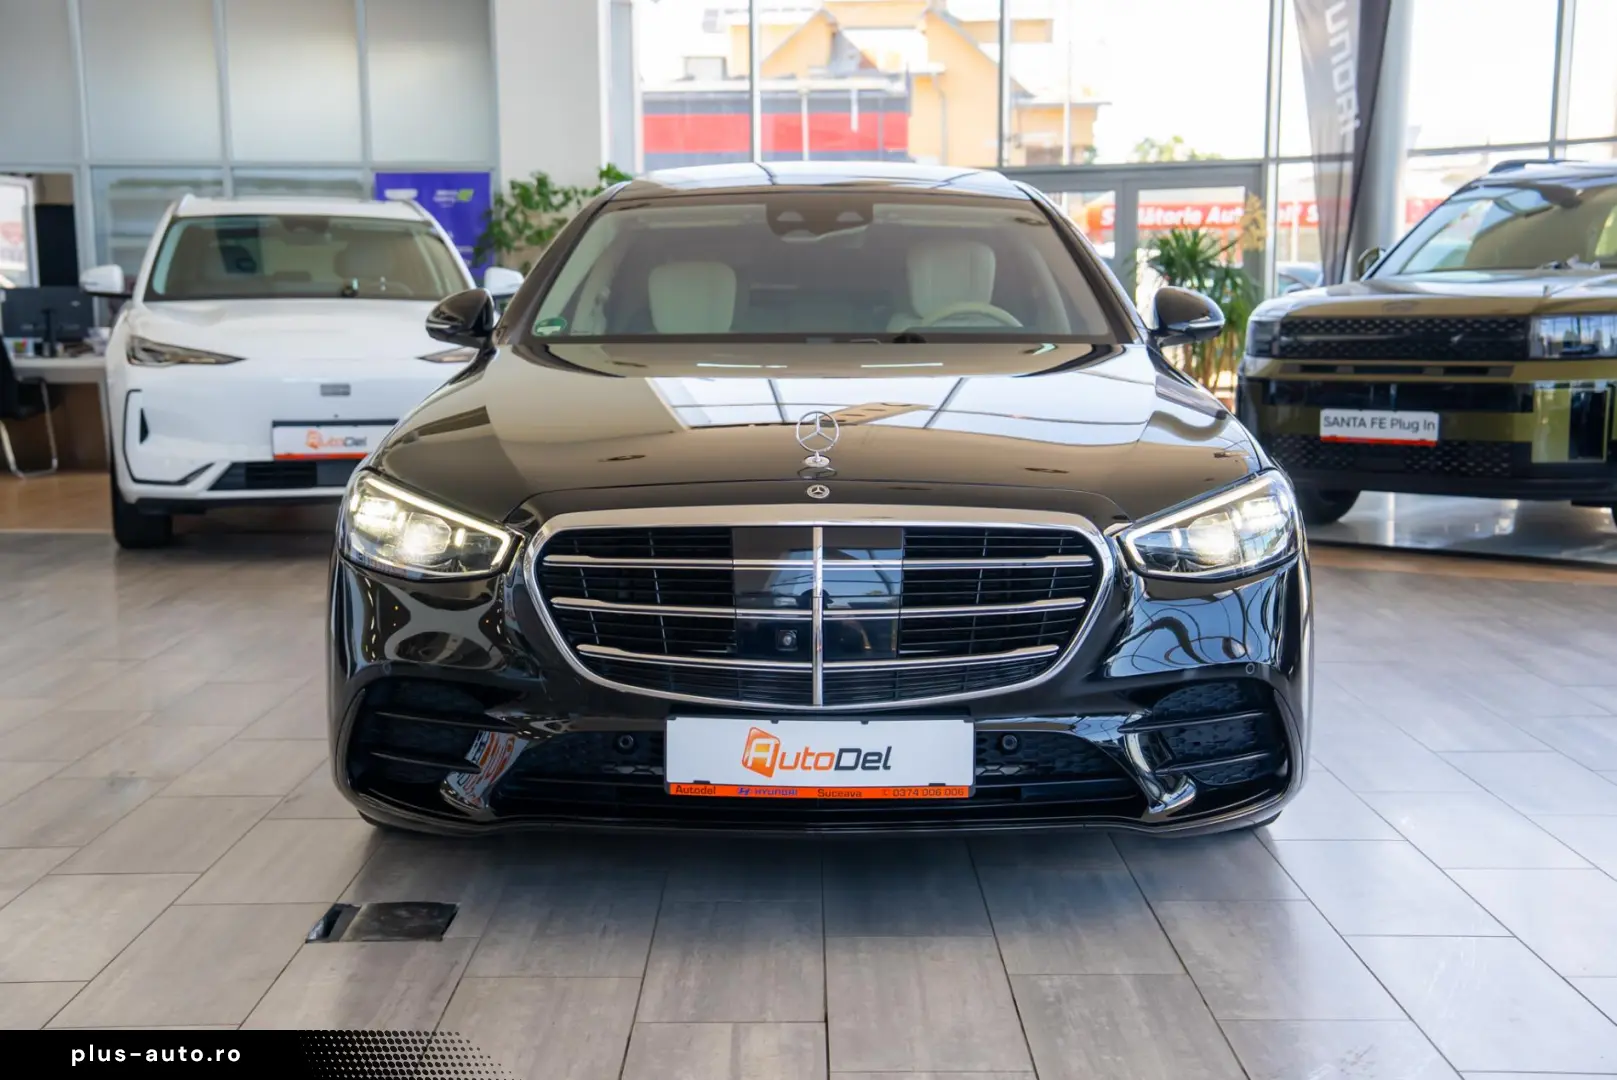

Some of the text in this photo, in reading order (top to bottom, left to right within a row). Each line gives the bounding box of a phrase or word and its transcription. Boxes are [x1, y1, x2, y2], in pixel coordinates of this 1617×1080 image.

[1205, 206, 1244, 224] Aut
[1323, 416, 1436, 434] SANTA FE Plug In
[742, 727, 892, 778] AutoDel
[675, 784, 716, 795] Autodel
[817, 788, 862, 798] Suceava
[892, 788, 919, 796] 0374
[921, 788, 942, 796] 006
[943, 788, 964, 796] 006
